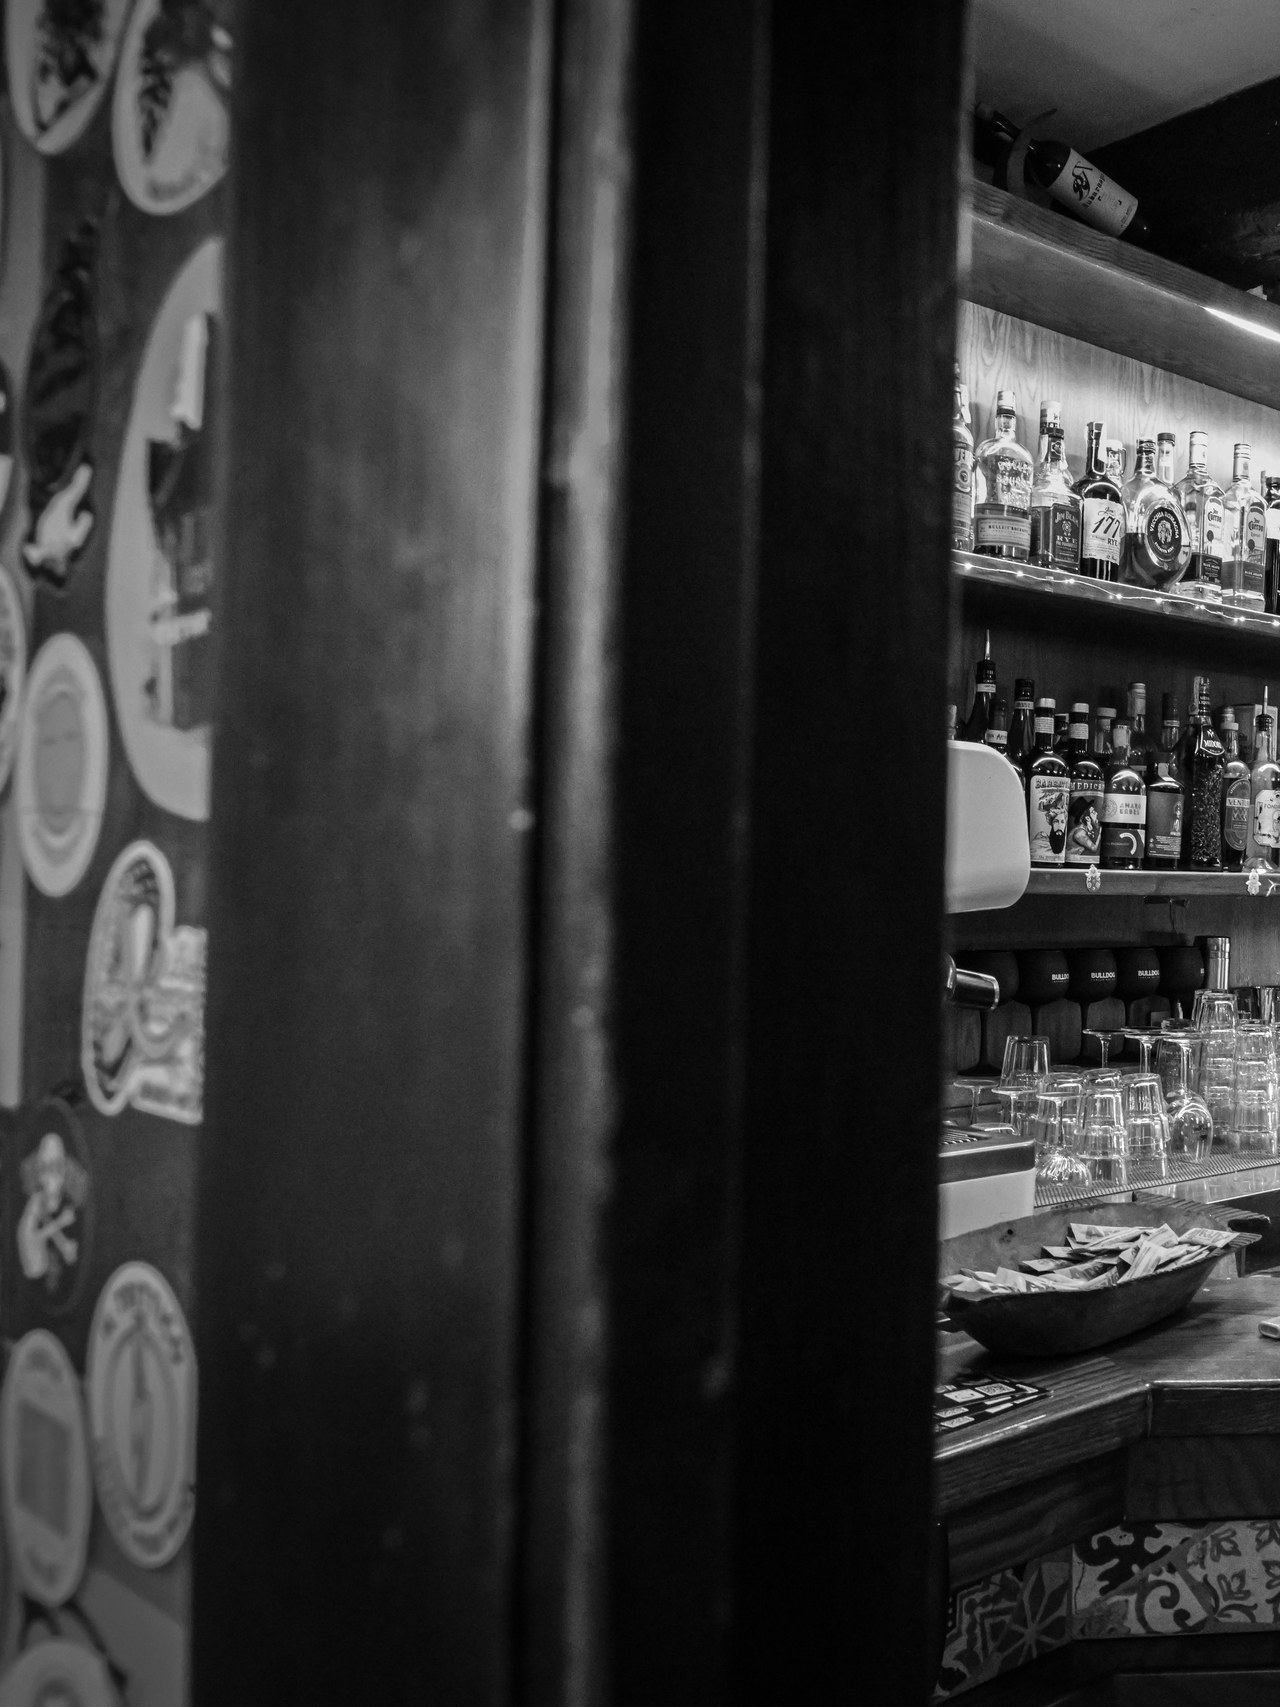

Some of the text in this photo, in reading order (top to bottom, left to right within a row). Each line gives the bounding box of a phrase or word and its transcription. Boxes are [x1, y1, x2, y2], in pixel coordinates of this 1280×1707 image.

[1149, 511, 1180, 539] VECCHIA ROMAGNA
[1107, 537, 1118, 547] RYE
[1091, 971, 1116, 979] BULLDOG
